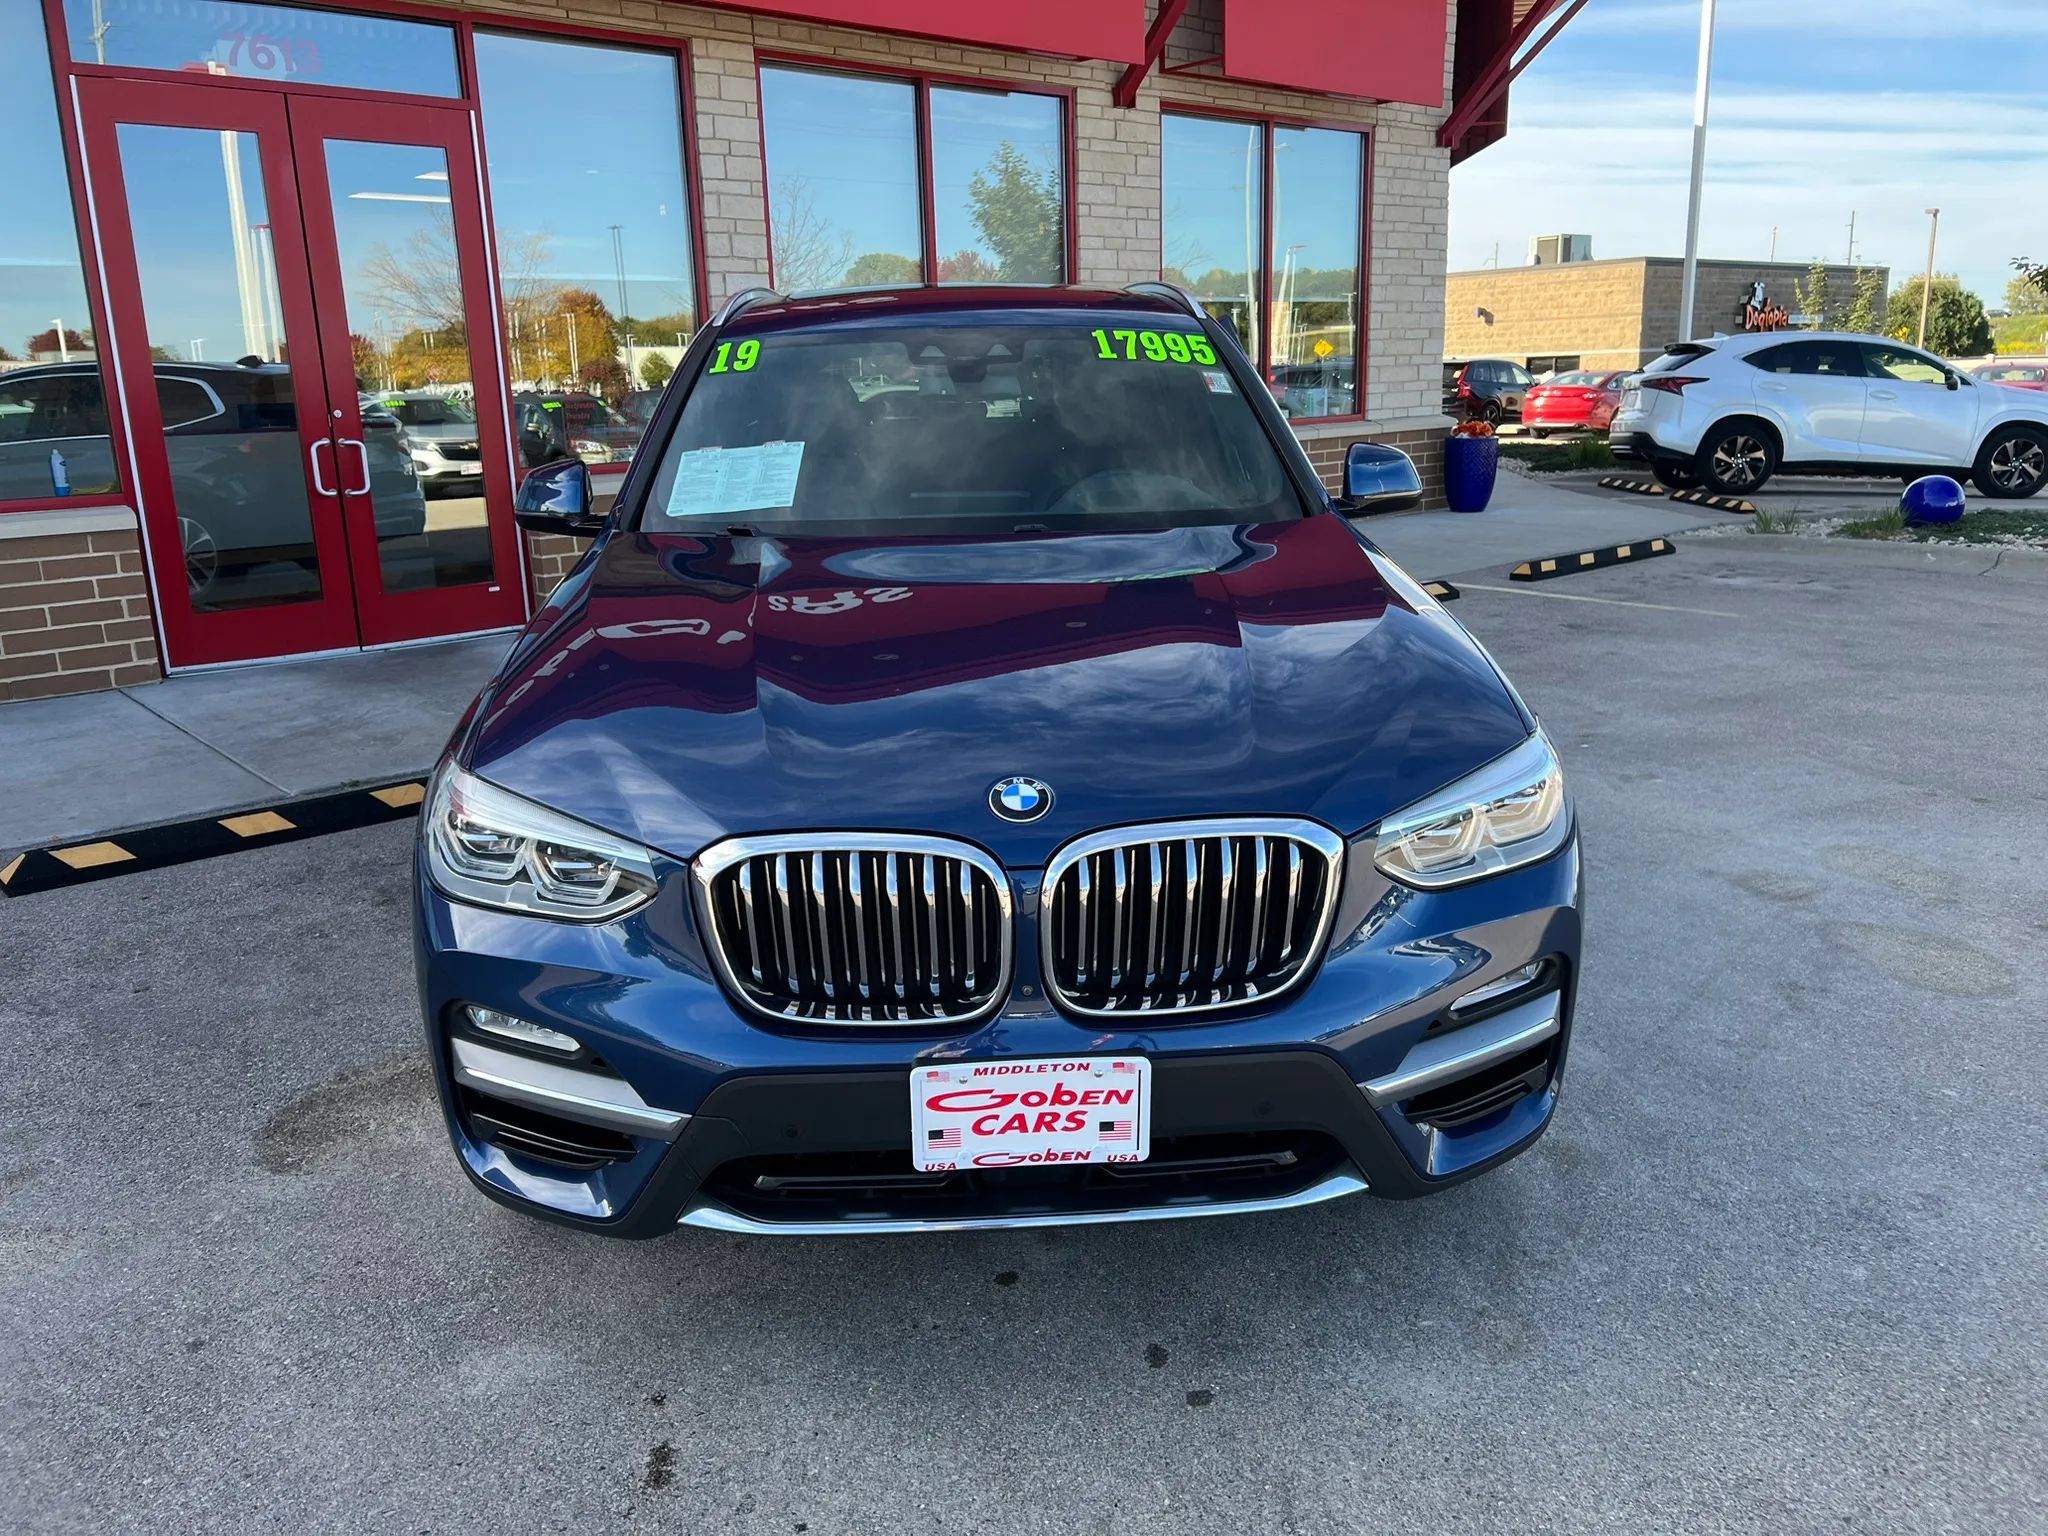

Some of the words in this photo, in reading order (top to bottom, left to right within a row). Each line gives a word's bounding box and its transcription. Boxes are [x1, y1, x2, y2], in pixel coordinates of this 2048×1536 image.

[222, 31, 320, 75] 7613
[1745, 297, 1788, 332] Dogtopia
[709, 340, 760, 374] 19
[1091, 329, 1217, 365] 17995
[995, 778, 1045, 792] BMW
[973, 1063, 1090, 1077] MIDDLETON
[971, 1110, 1088, 1137] CARS
[925, 1162, 957, 1172] USA
[1107, 1154, 1139, 1163] USA
